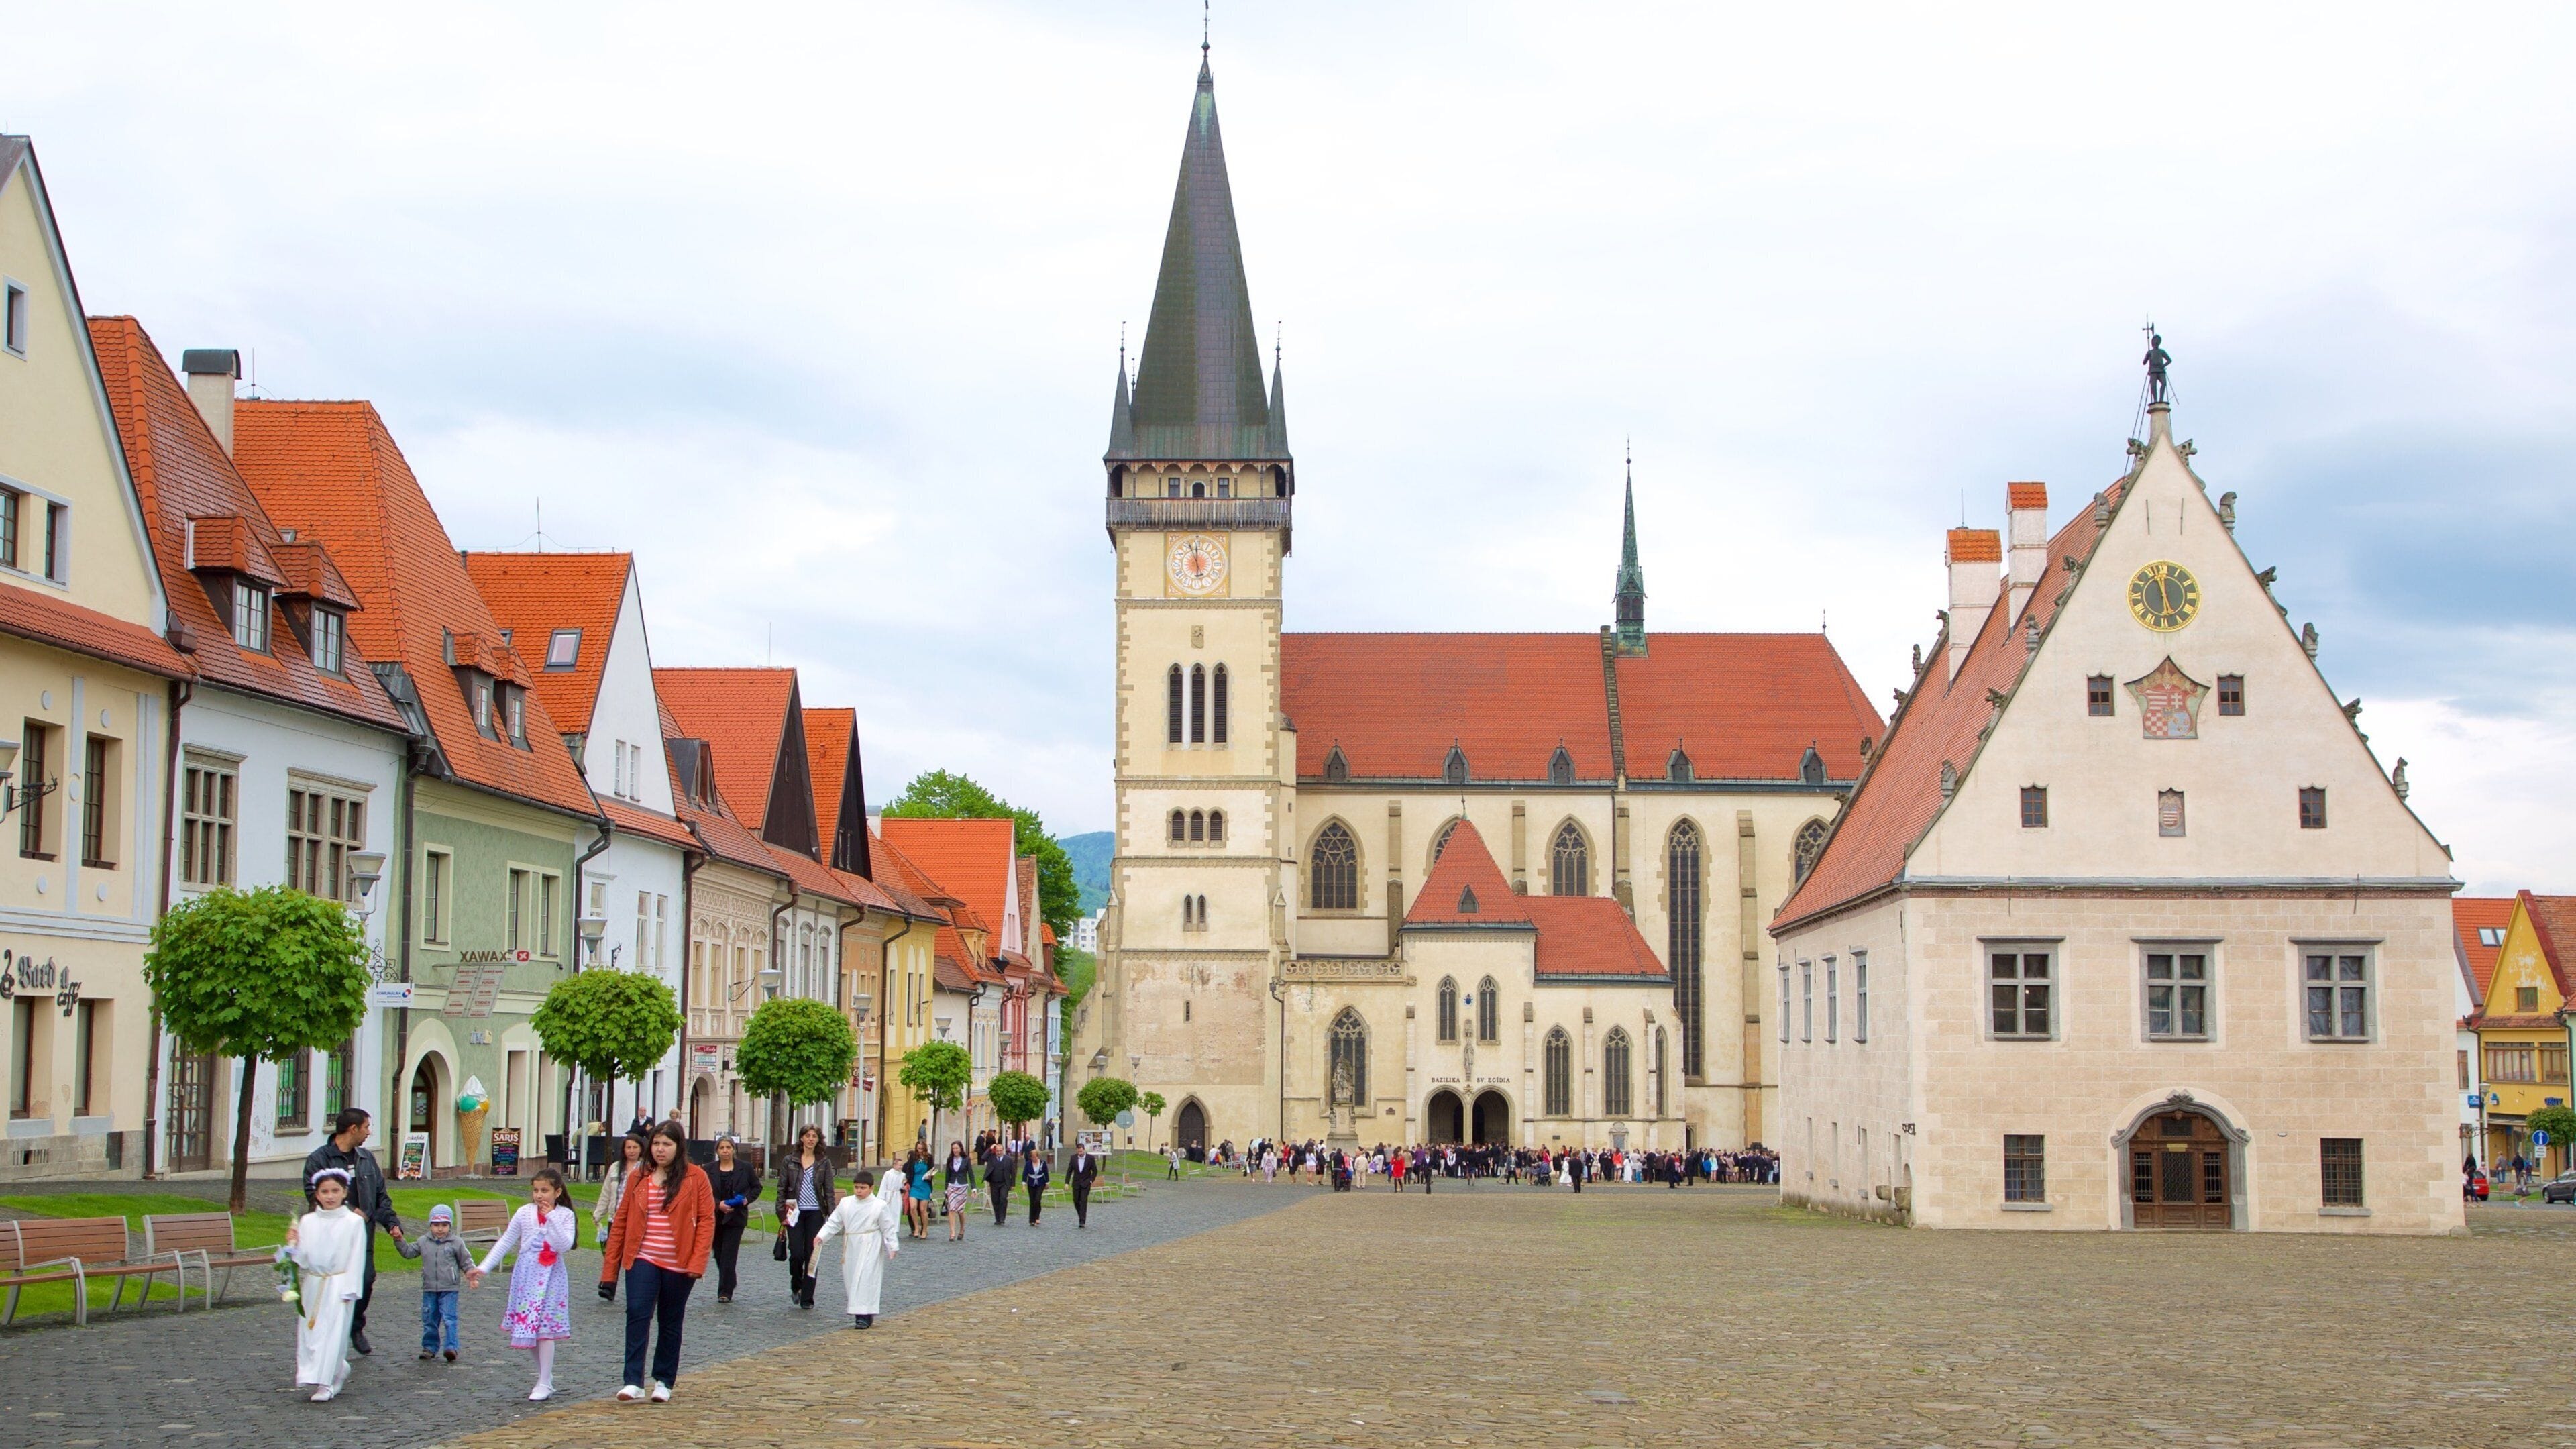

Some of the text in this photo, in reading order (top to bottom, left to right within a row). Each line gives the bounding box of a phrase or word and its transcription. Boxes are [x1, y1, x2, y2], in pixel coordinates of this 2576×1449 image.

[2174, 568, 2180, 577] I
[2182, 579, 2192, 587] II
[460, 951, 508, 963] XAWAX
